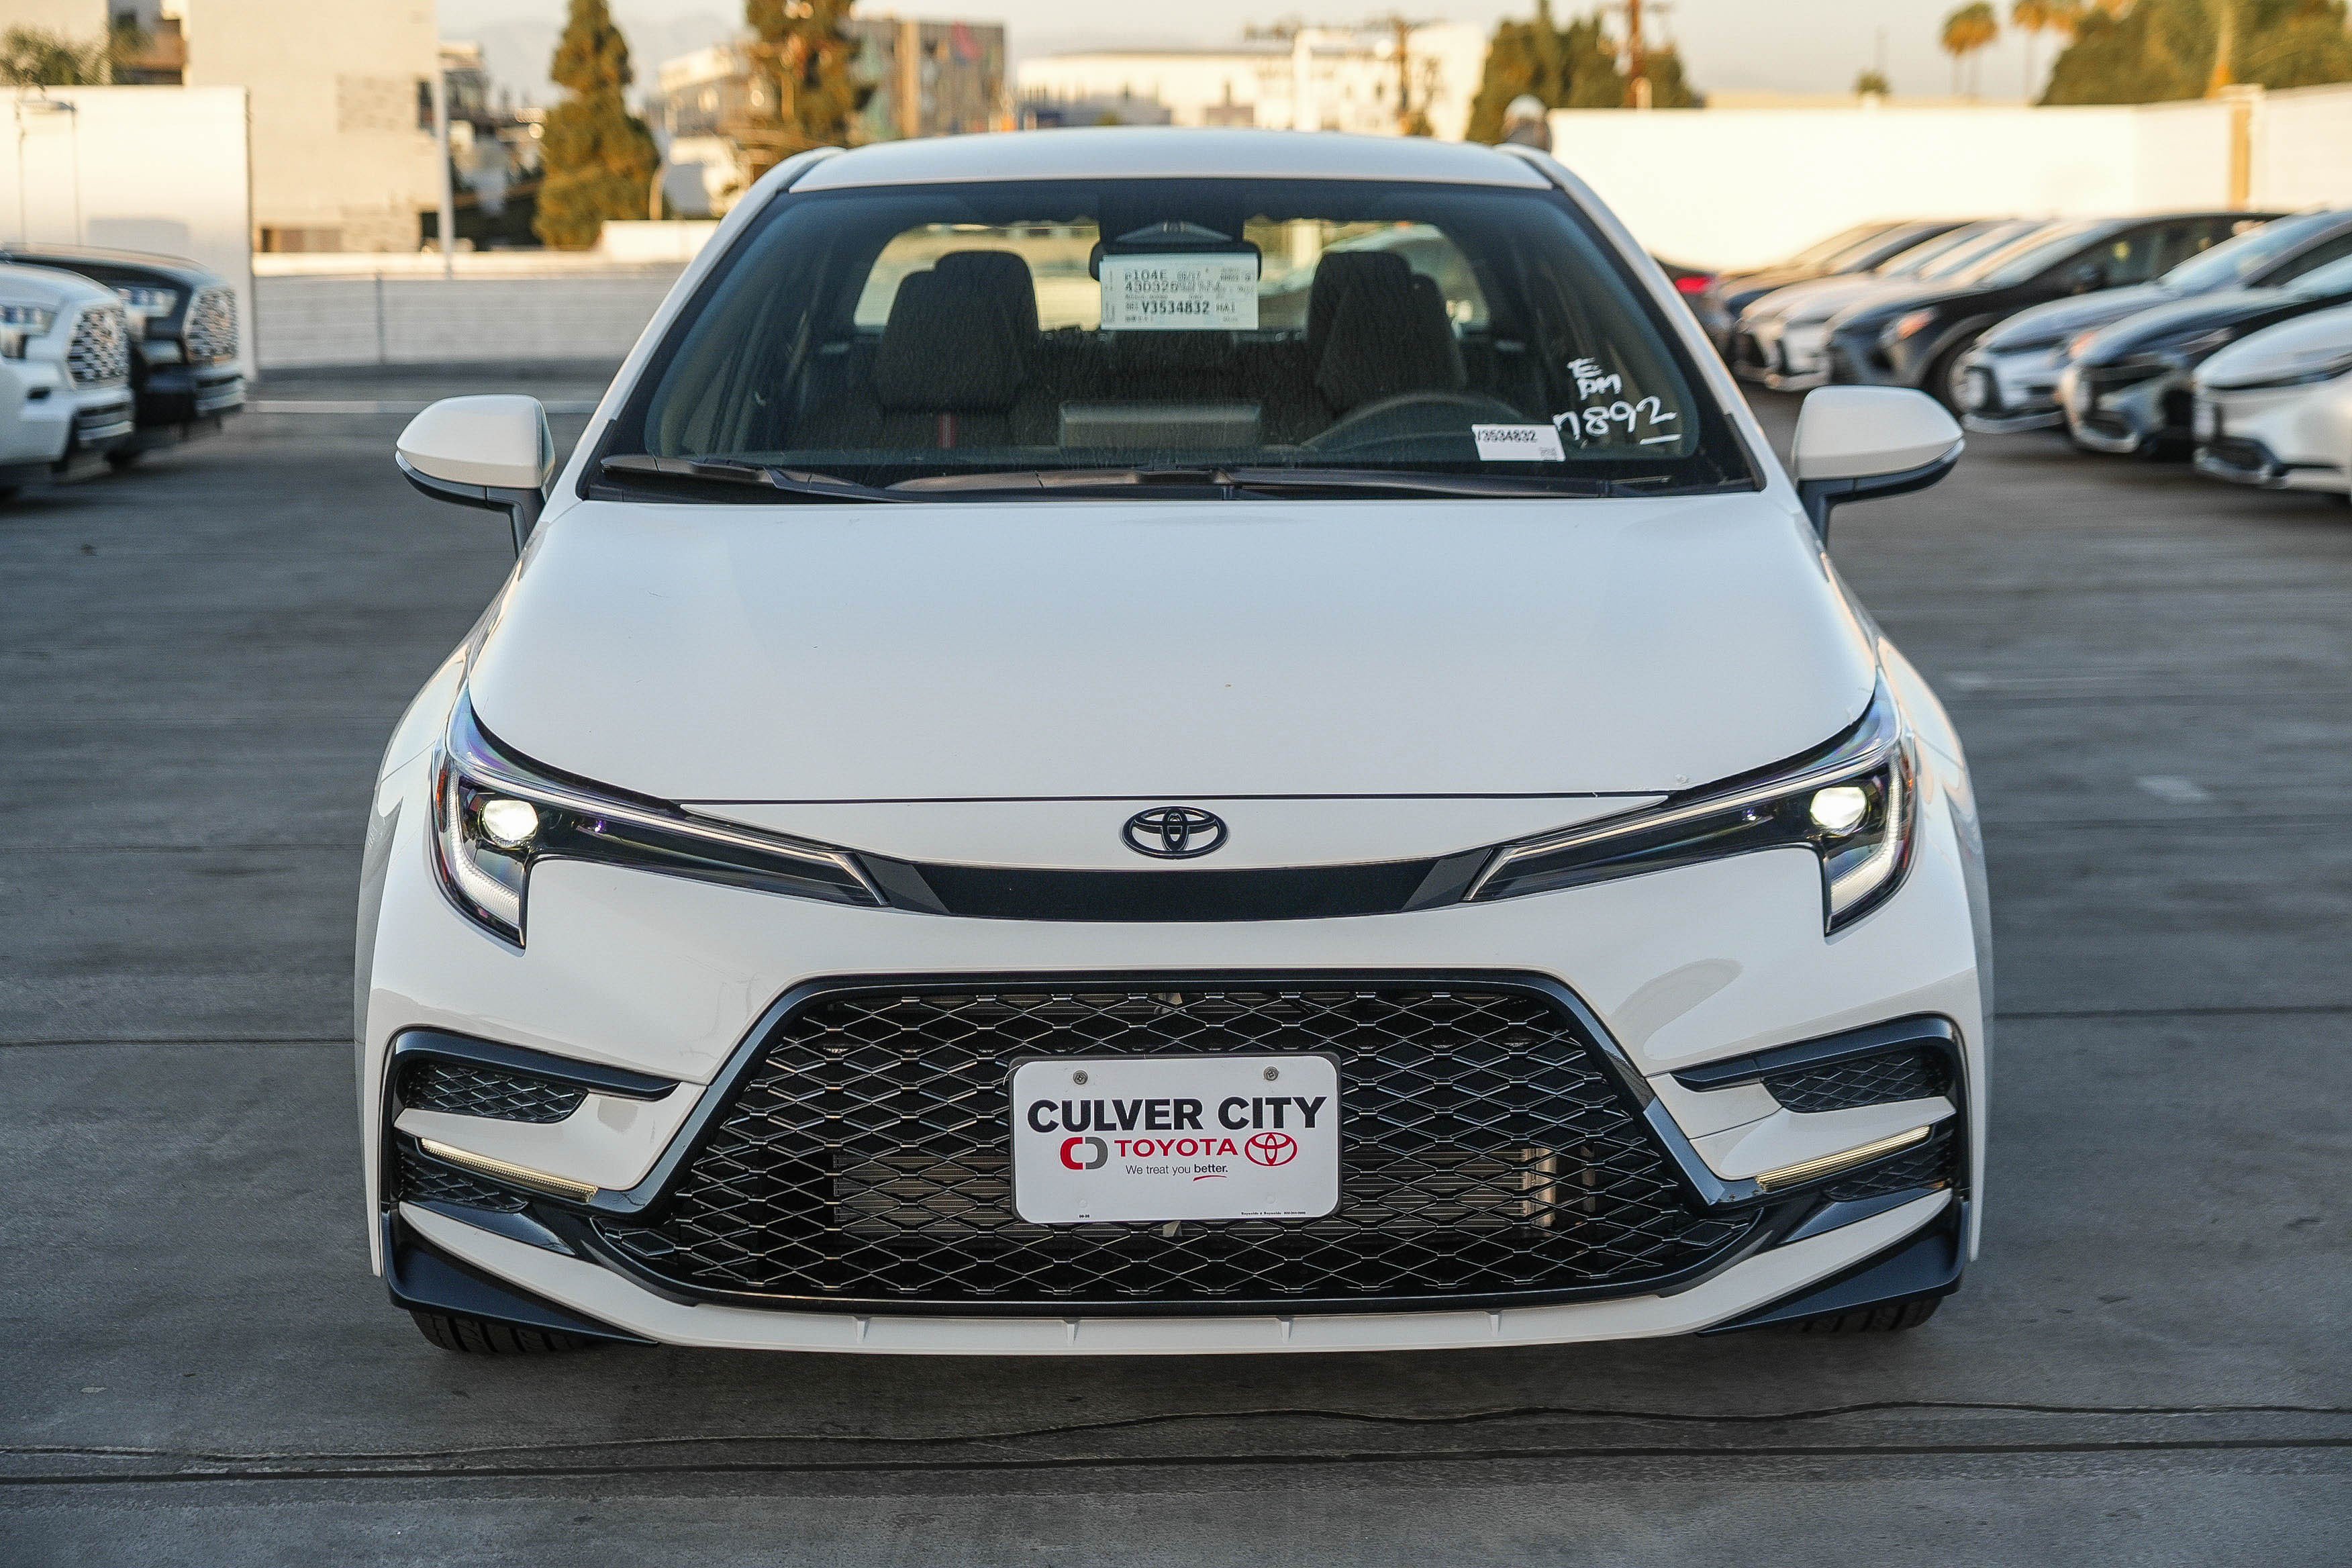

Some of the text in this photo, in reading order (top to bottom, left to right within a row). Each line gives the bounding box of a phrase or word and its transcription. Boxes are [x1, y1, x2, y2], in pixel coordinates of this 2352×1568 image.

[1141, 301, 1210, 315] V3534832
[1027, 1096, 1328, 1133] CULVER CITY
[1114, 1138, 1238, 1157] TOYOTA
[1125, 1163, 1228, 1176] We treat you better.
